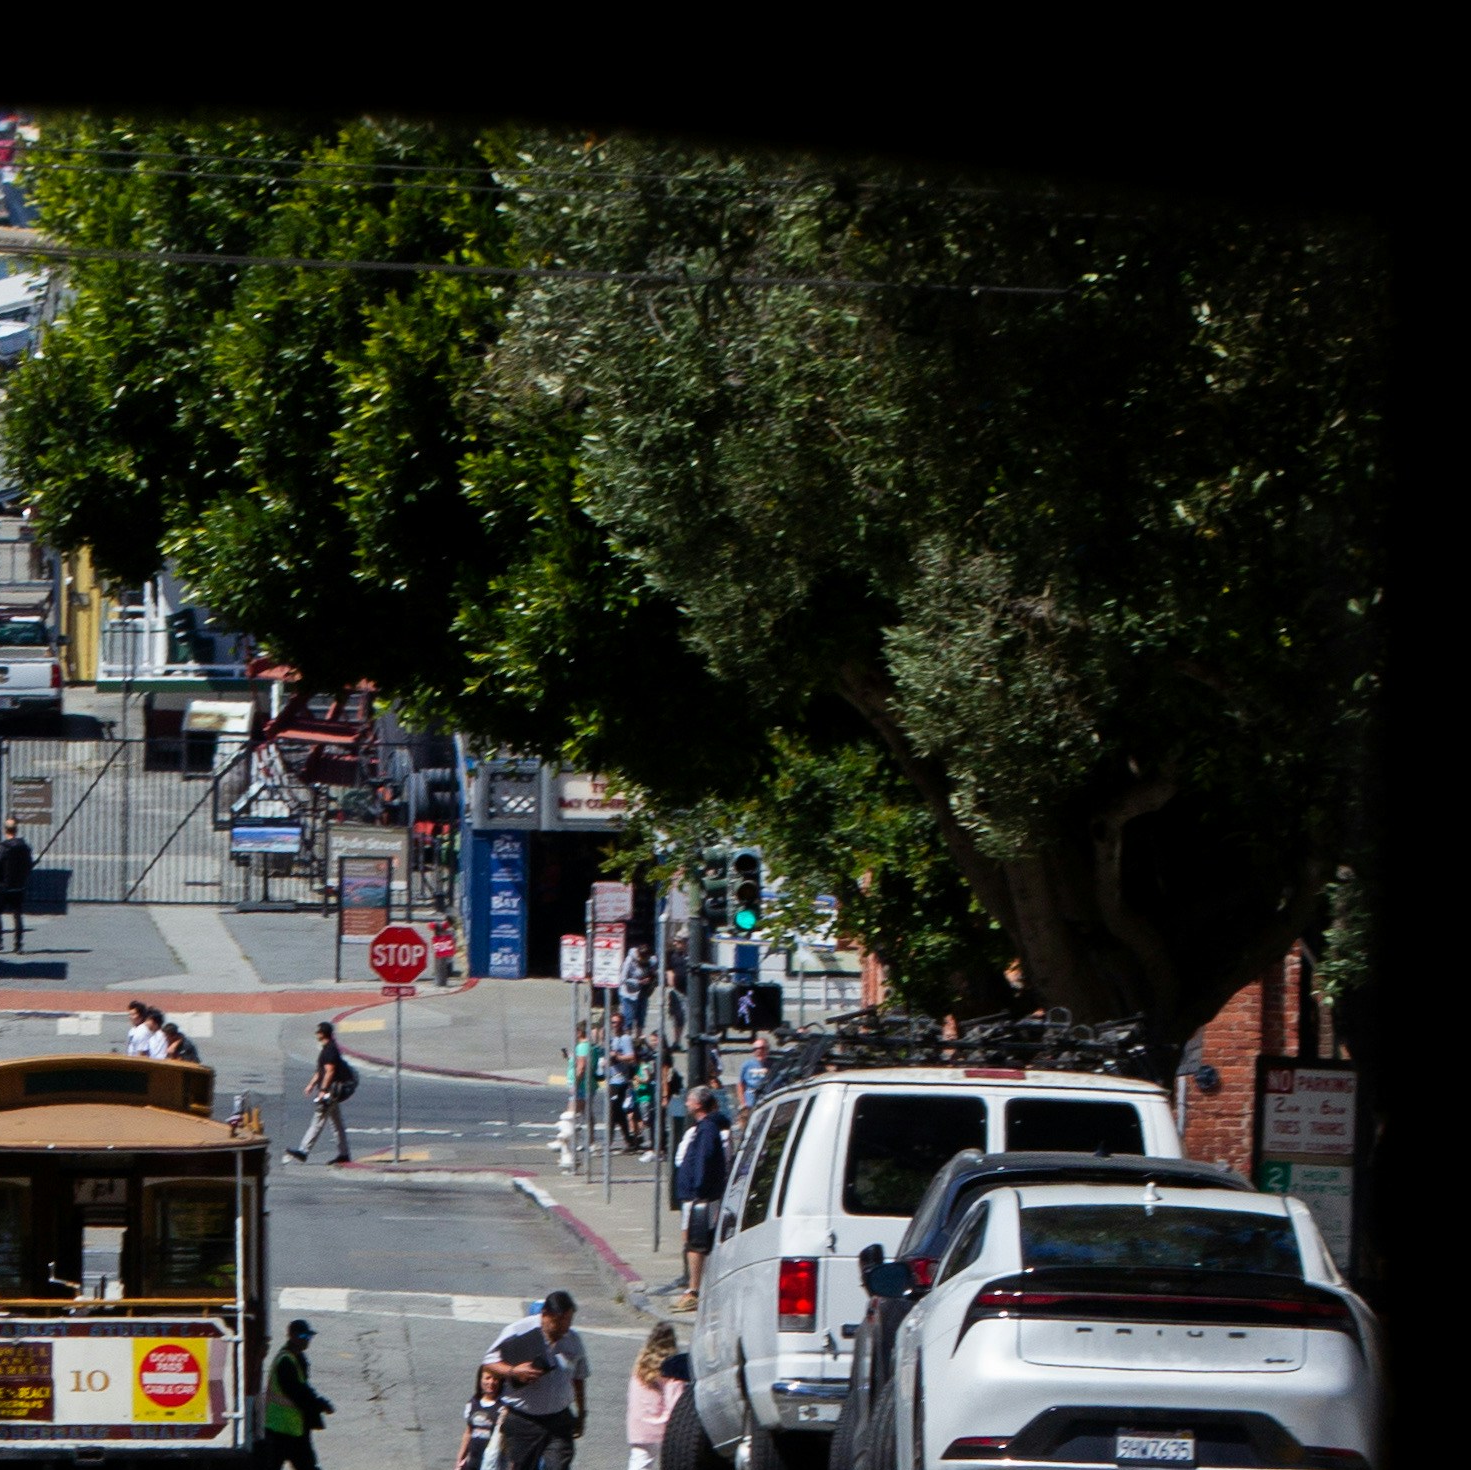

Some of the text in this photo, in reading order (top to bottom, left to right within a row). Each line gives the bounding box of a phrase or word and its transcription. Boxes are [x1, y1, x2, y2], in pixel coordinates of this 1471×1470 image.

[491, 896, 522, 909] BAY
[372, 943, 425, 967] STOP
[490, 952, 521, 965] BAY
[1267, 1070, 1354, 1093] NO PARKING
[1075, 1326, 1247, 1339] PRIUS
[148, 1352, 190, 1363] DO NOT
[155, 1362, 185, 1372] PASS
[69, 1369, 110, 1392] 10
[144, 1385, 196, 1395] CABLE CAR
